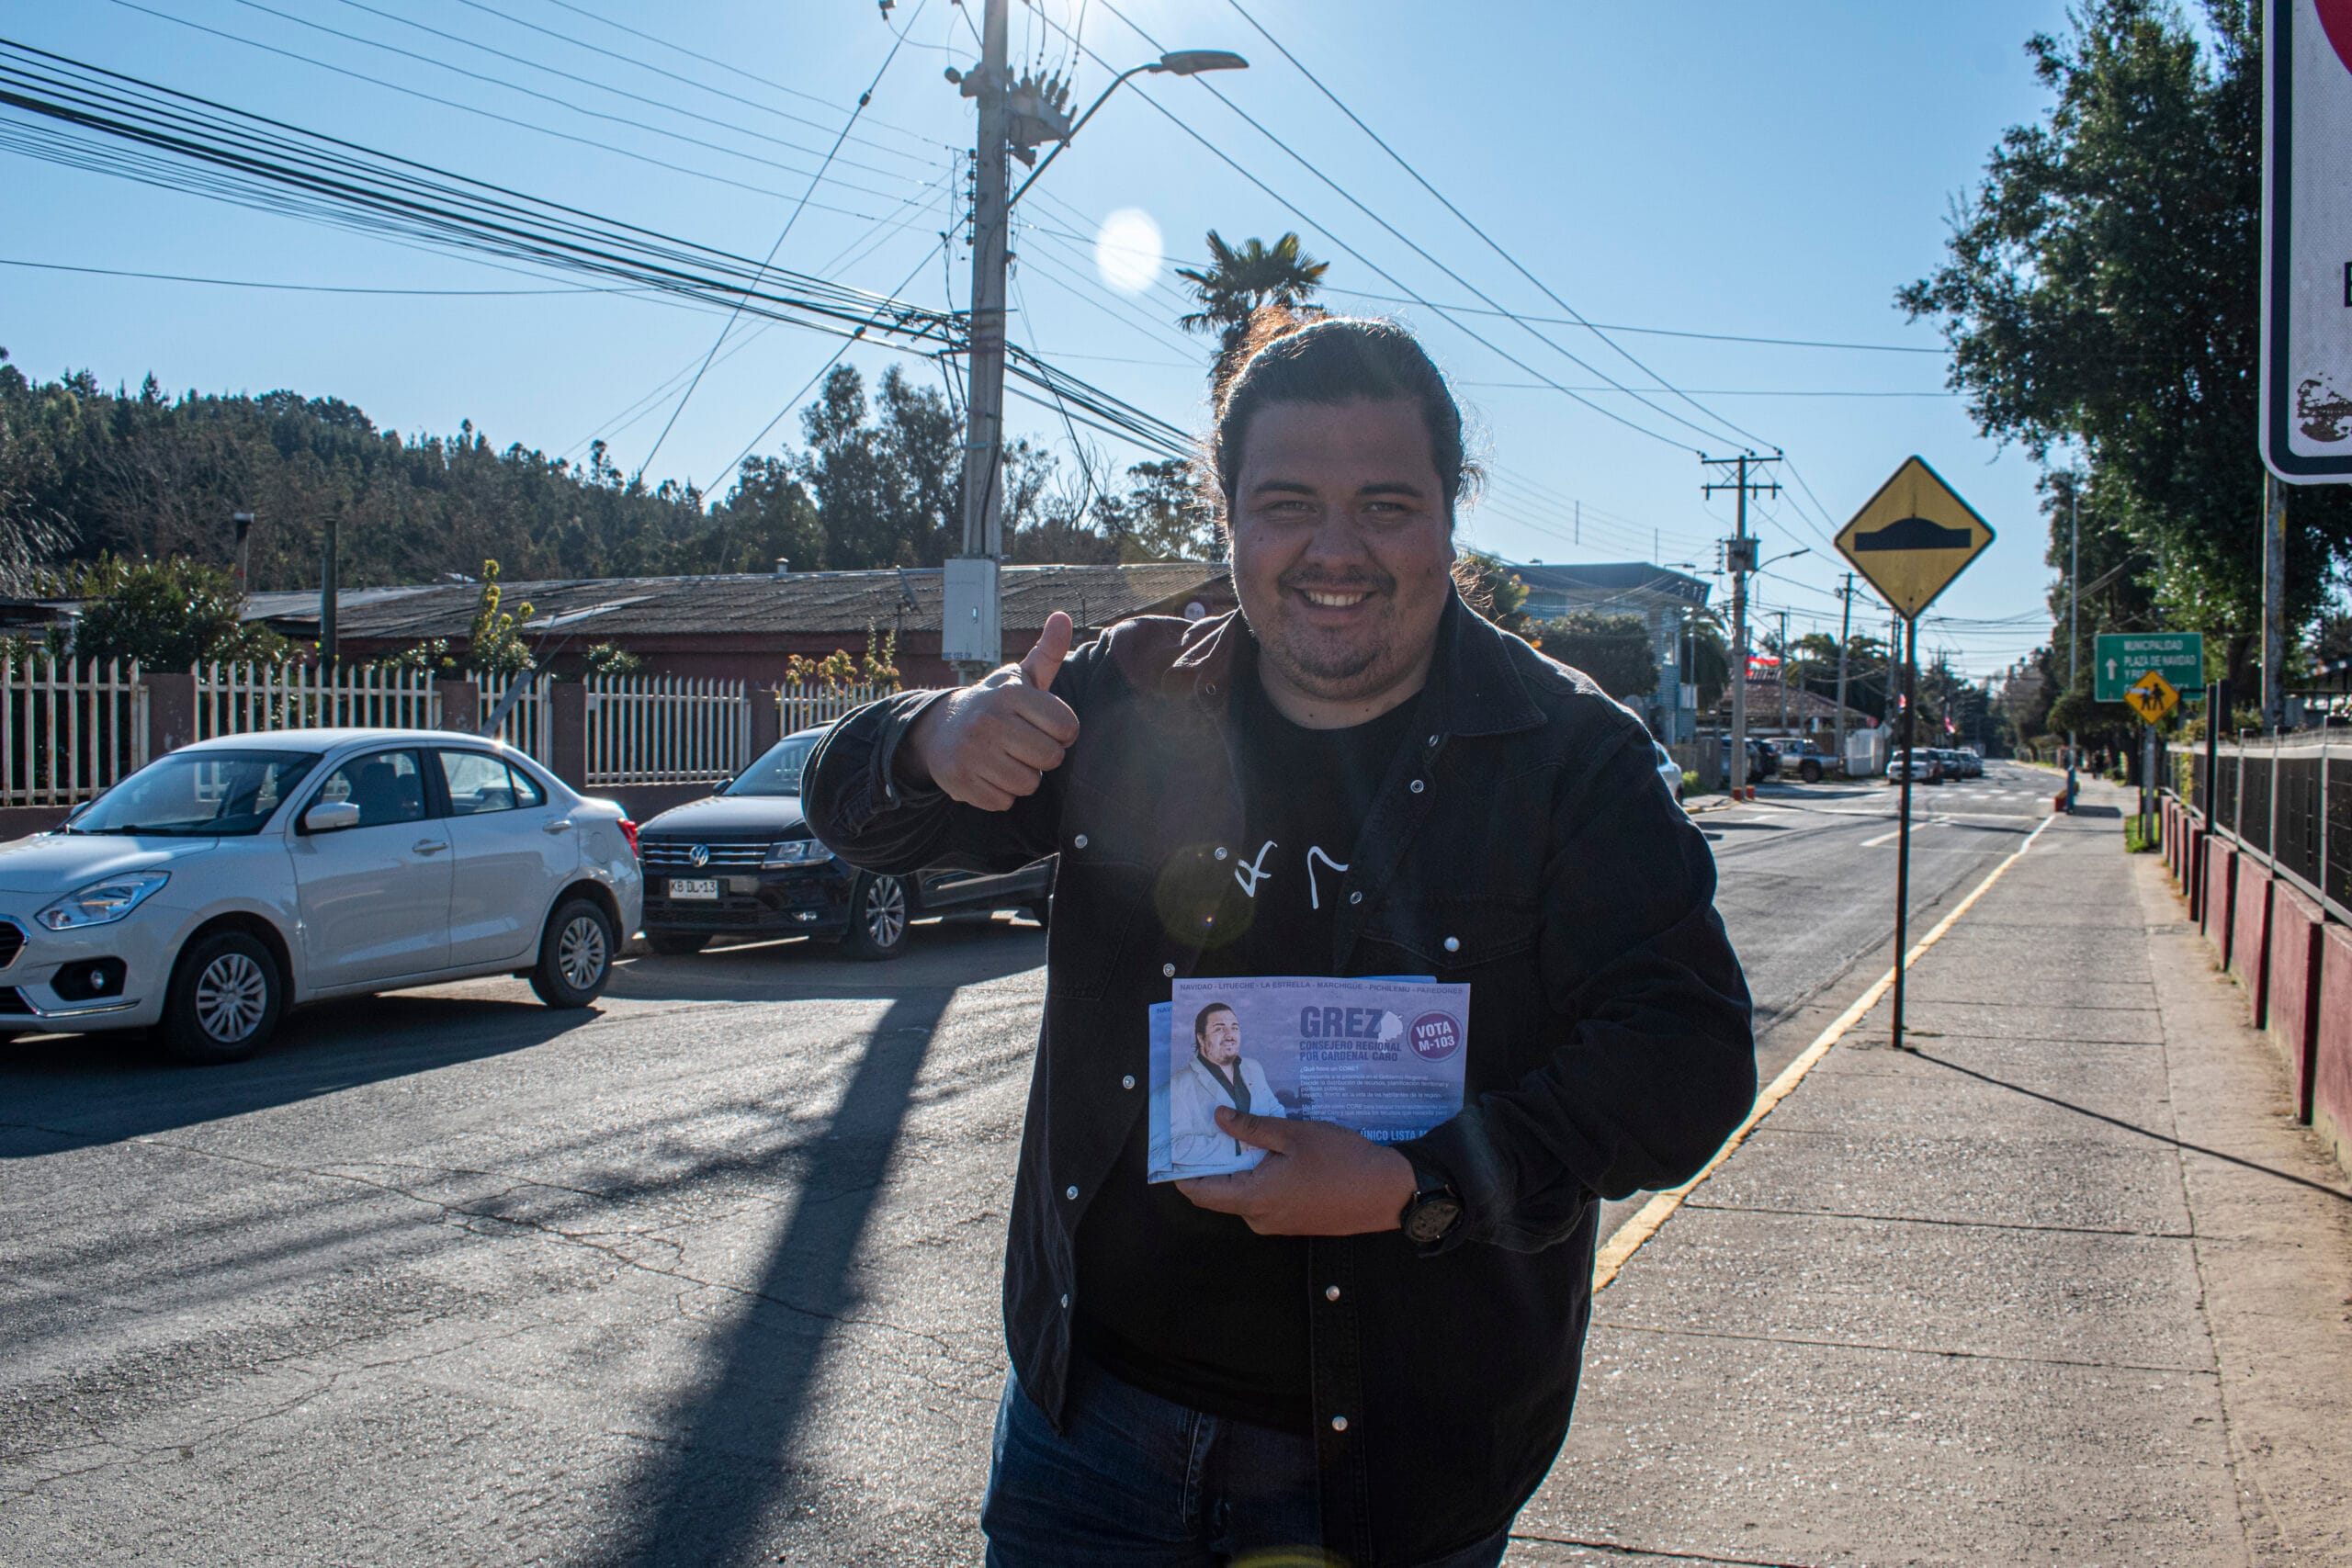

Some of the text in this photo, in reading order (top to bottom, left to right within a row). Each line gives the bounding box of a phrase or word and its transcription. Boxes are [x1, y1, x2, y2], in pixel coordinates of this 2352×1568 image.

[2124, 656, 2149, 667] PLAZA
[1181, 983, 1213, 991] NAVIDAD
[1218, 982, 1255, 990] LITUECHE
[1369, 984, 1410, 993] PICHILEMU
[1300, 1006, 1383, 1038] GREZ
[1416, 1021, 1452, 1038] VOTA
[1300, 1041, 1402, 1052] CONSEJERO REGIONAL
[1419, 1035, 1455, 1052] M-103
[1300, 1051, 1398, 1062] POR CARDENAL CARO
[1390, 1130, 1416, 1141] LISTA
